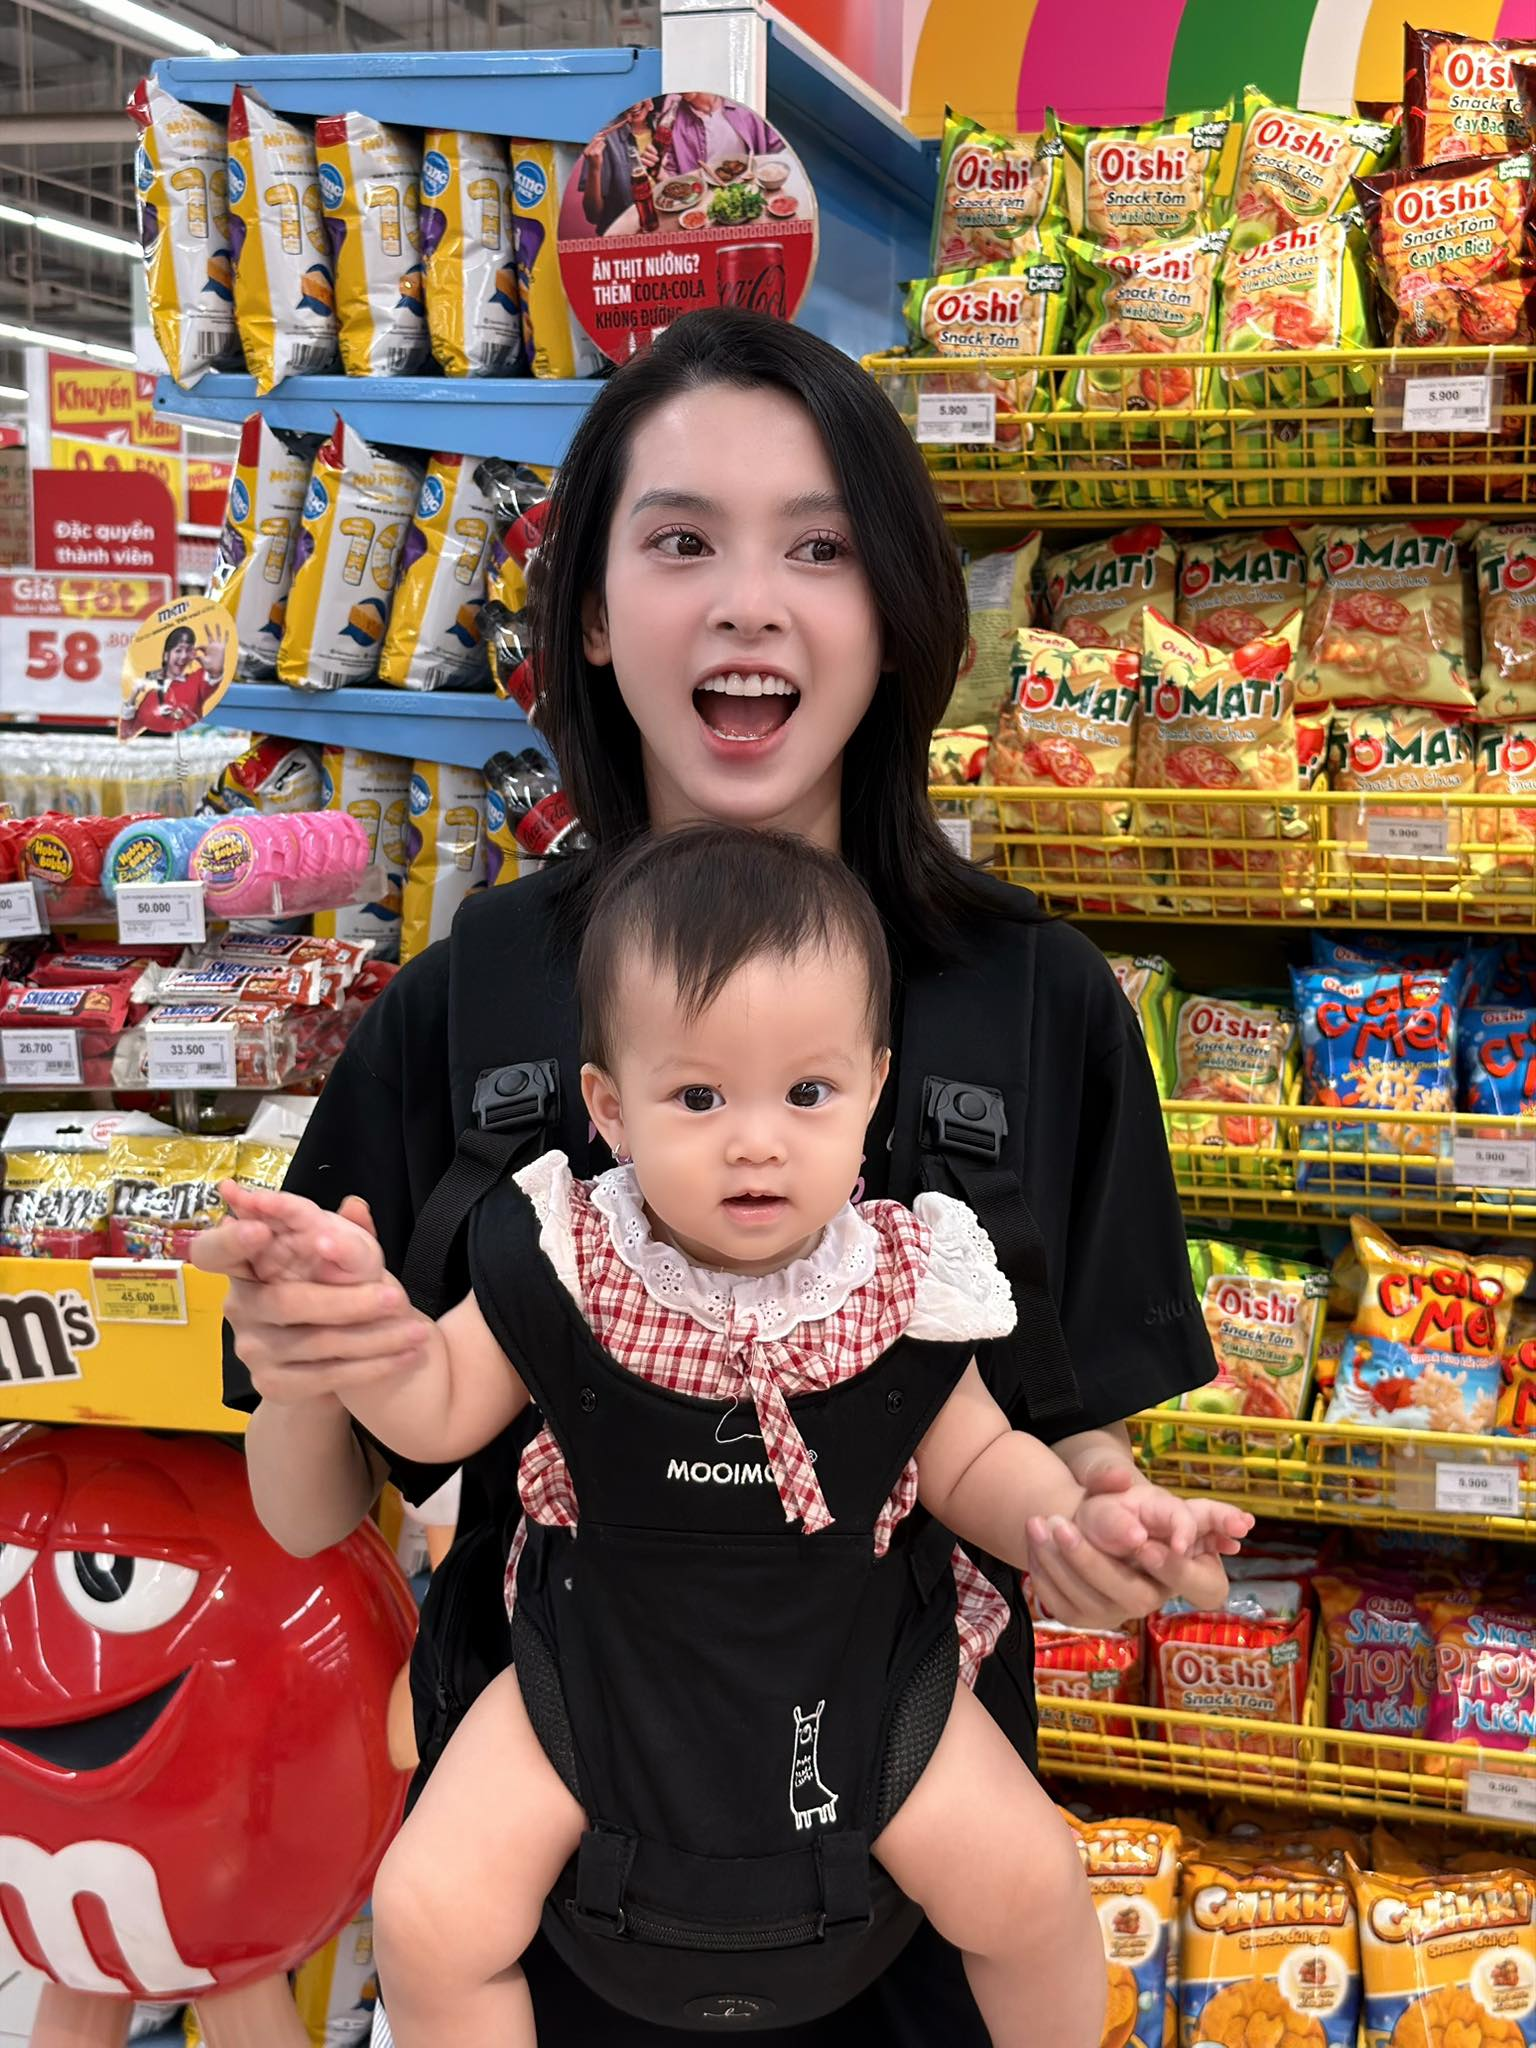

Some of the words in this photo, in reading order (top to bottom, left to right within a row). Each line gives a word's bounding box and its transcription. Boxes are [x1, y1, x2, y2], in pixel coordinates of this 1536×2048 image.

[1450, 95, 1499, 111] Snack
[1454, 116, 1479, 135] Cay
[1257, 119, 1340, 164] Oishi
[956, 154, 1031, 193] Oishi
[1100, 147, 1186, 182] Oishi
[1252, 153, 1291, 172] Snack
[1106, 191, 1150, 206] Snack
[1396, 181, 1490, 226] Oishi
[1402, 223, 1454, 249] Snack
[592, 256, 610, 281] ĂN
[613, 257, 643, 284] THỊT
[1409, 252, 1435, 270] Cay
[593, 280, 632, 306] THÊM
[595, 306, 637, 329] KHÔNG
[937, 292, 1021, 324] Oishi
[940, 331, 986, 346] Snack
[1428, 389, 1460, 402] 5.900
[938, 404, 968, 416] 5.900
[25, 629, 102, 682] 58
[1009, 663, 1141, 727] TOMAT
[138, 902, 171, 914] 50.000
[23, 991, 82, 1006] SNICKERS
[1316, 974, 1442, 1039] Crab
[1190, 1007, 1271, 1040] Oishi
[19, 1042, 53, 1055] 26.700
[171, 1044, 205, 1056] 33.500
[121, 1291, 156, 1303] 45.600
[1378, 1268, 1504, 1318] Crab
[1218, 1286, 1298, 1326] Oishi
[1220, 1320, 1264, 1341] Snack
[1174, 1651, 1272, 1690] Oishi
[1183, 1690, 1234, 1707] Snack
